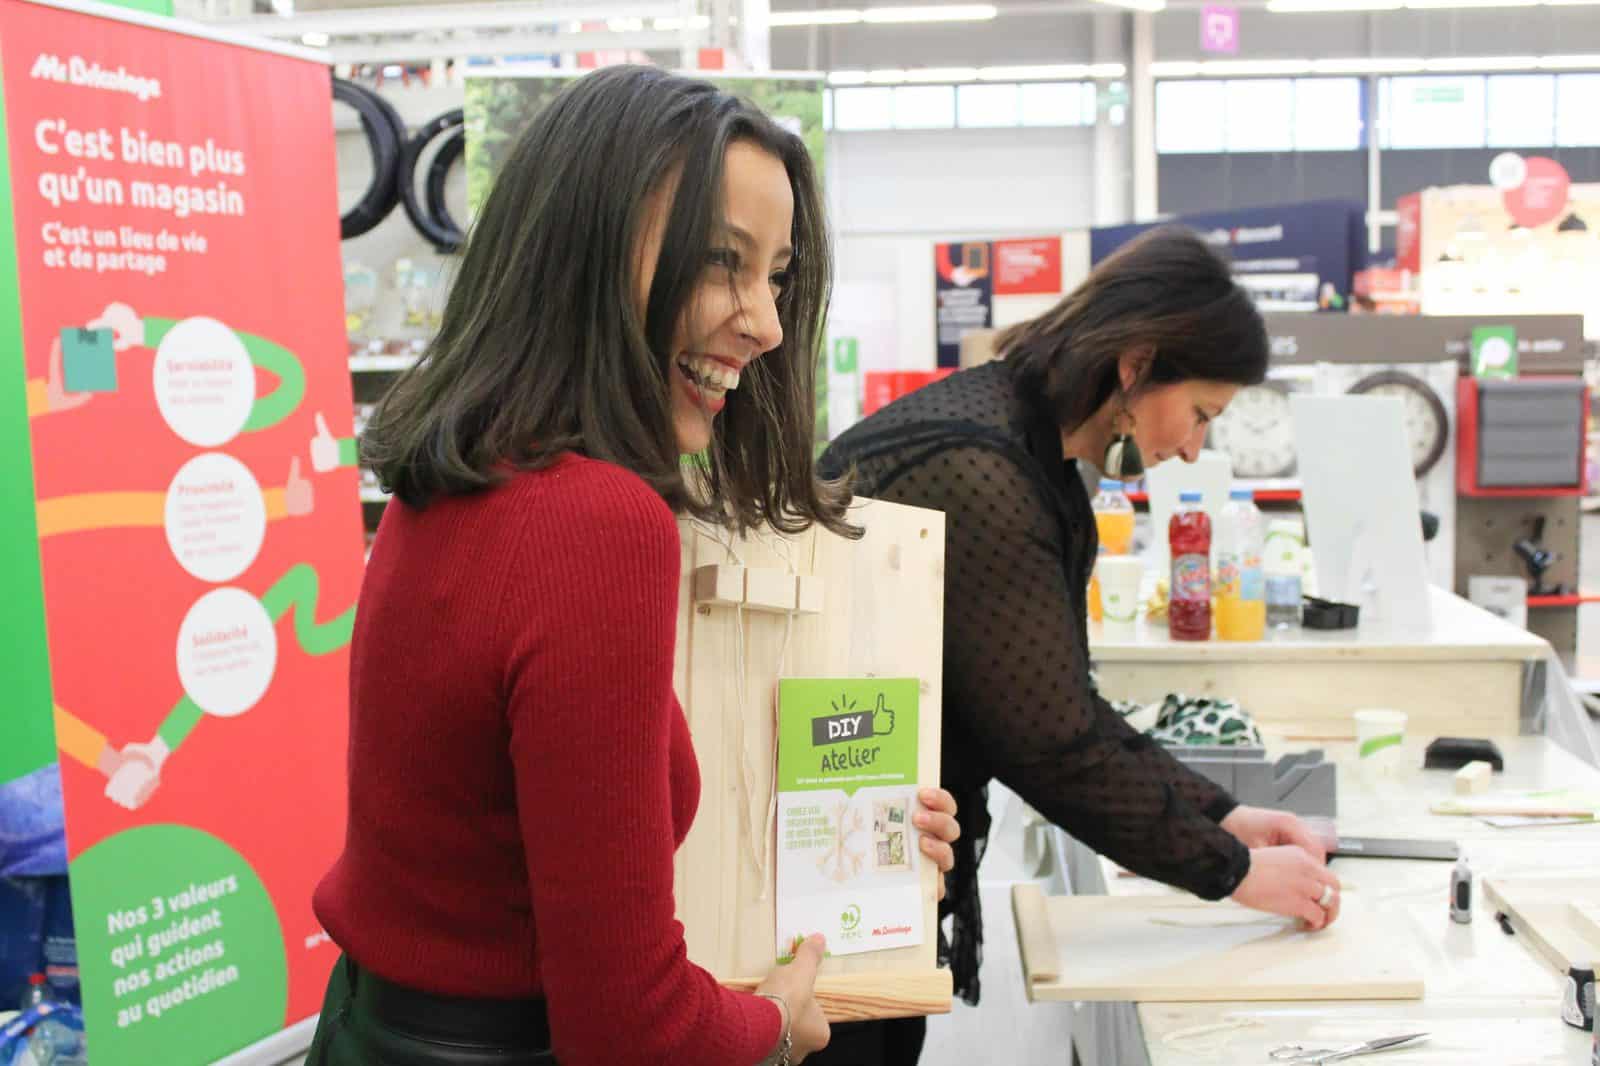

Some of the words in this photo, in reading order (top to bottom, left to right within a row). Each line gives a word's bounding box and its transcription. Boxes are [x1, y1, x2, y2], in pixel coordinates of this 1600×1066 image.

[35, 119, 114, 160] C'est
[121, 128, 185, 168] bien
[189, 139, 245, 176] plus
[38, 167, 124, 207] qu'un
[131, 181, 244, 217] magasin
[41, 222, 90, 247] C'est
[93, 231, 117, 247] un
[119, 226, 154, 250] lieu
[155, 229, 179, 251] de
[181, 232, 208, 253] vie
[43, 247, 66, 268] et
[69, 247, 94, 270] de
[96, 251, 167, 276] partage
[828, 715, 863, 739] DIY
[821, 746, 881, 773] Atelier
[107, 906, 148, 935] Nos
[151, 897, 165, 920] 3
[168, 875, 238, 912] valeurs
[111, 934, 143, 968] qui
[147, 909, 222, 957] guident
[114, 969, 151, 997] nos
[155, 940, 225, 981] actions
[117, 1004, 142, 1027] au
[146, 965, 239, 1017] quotidien
